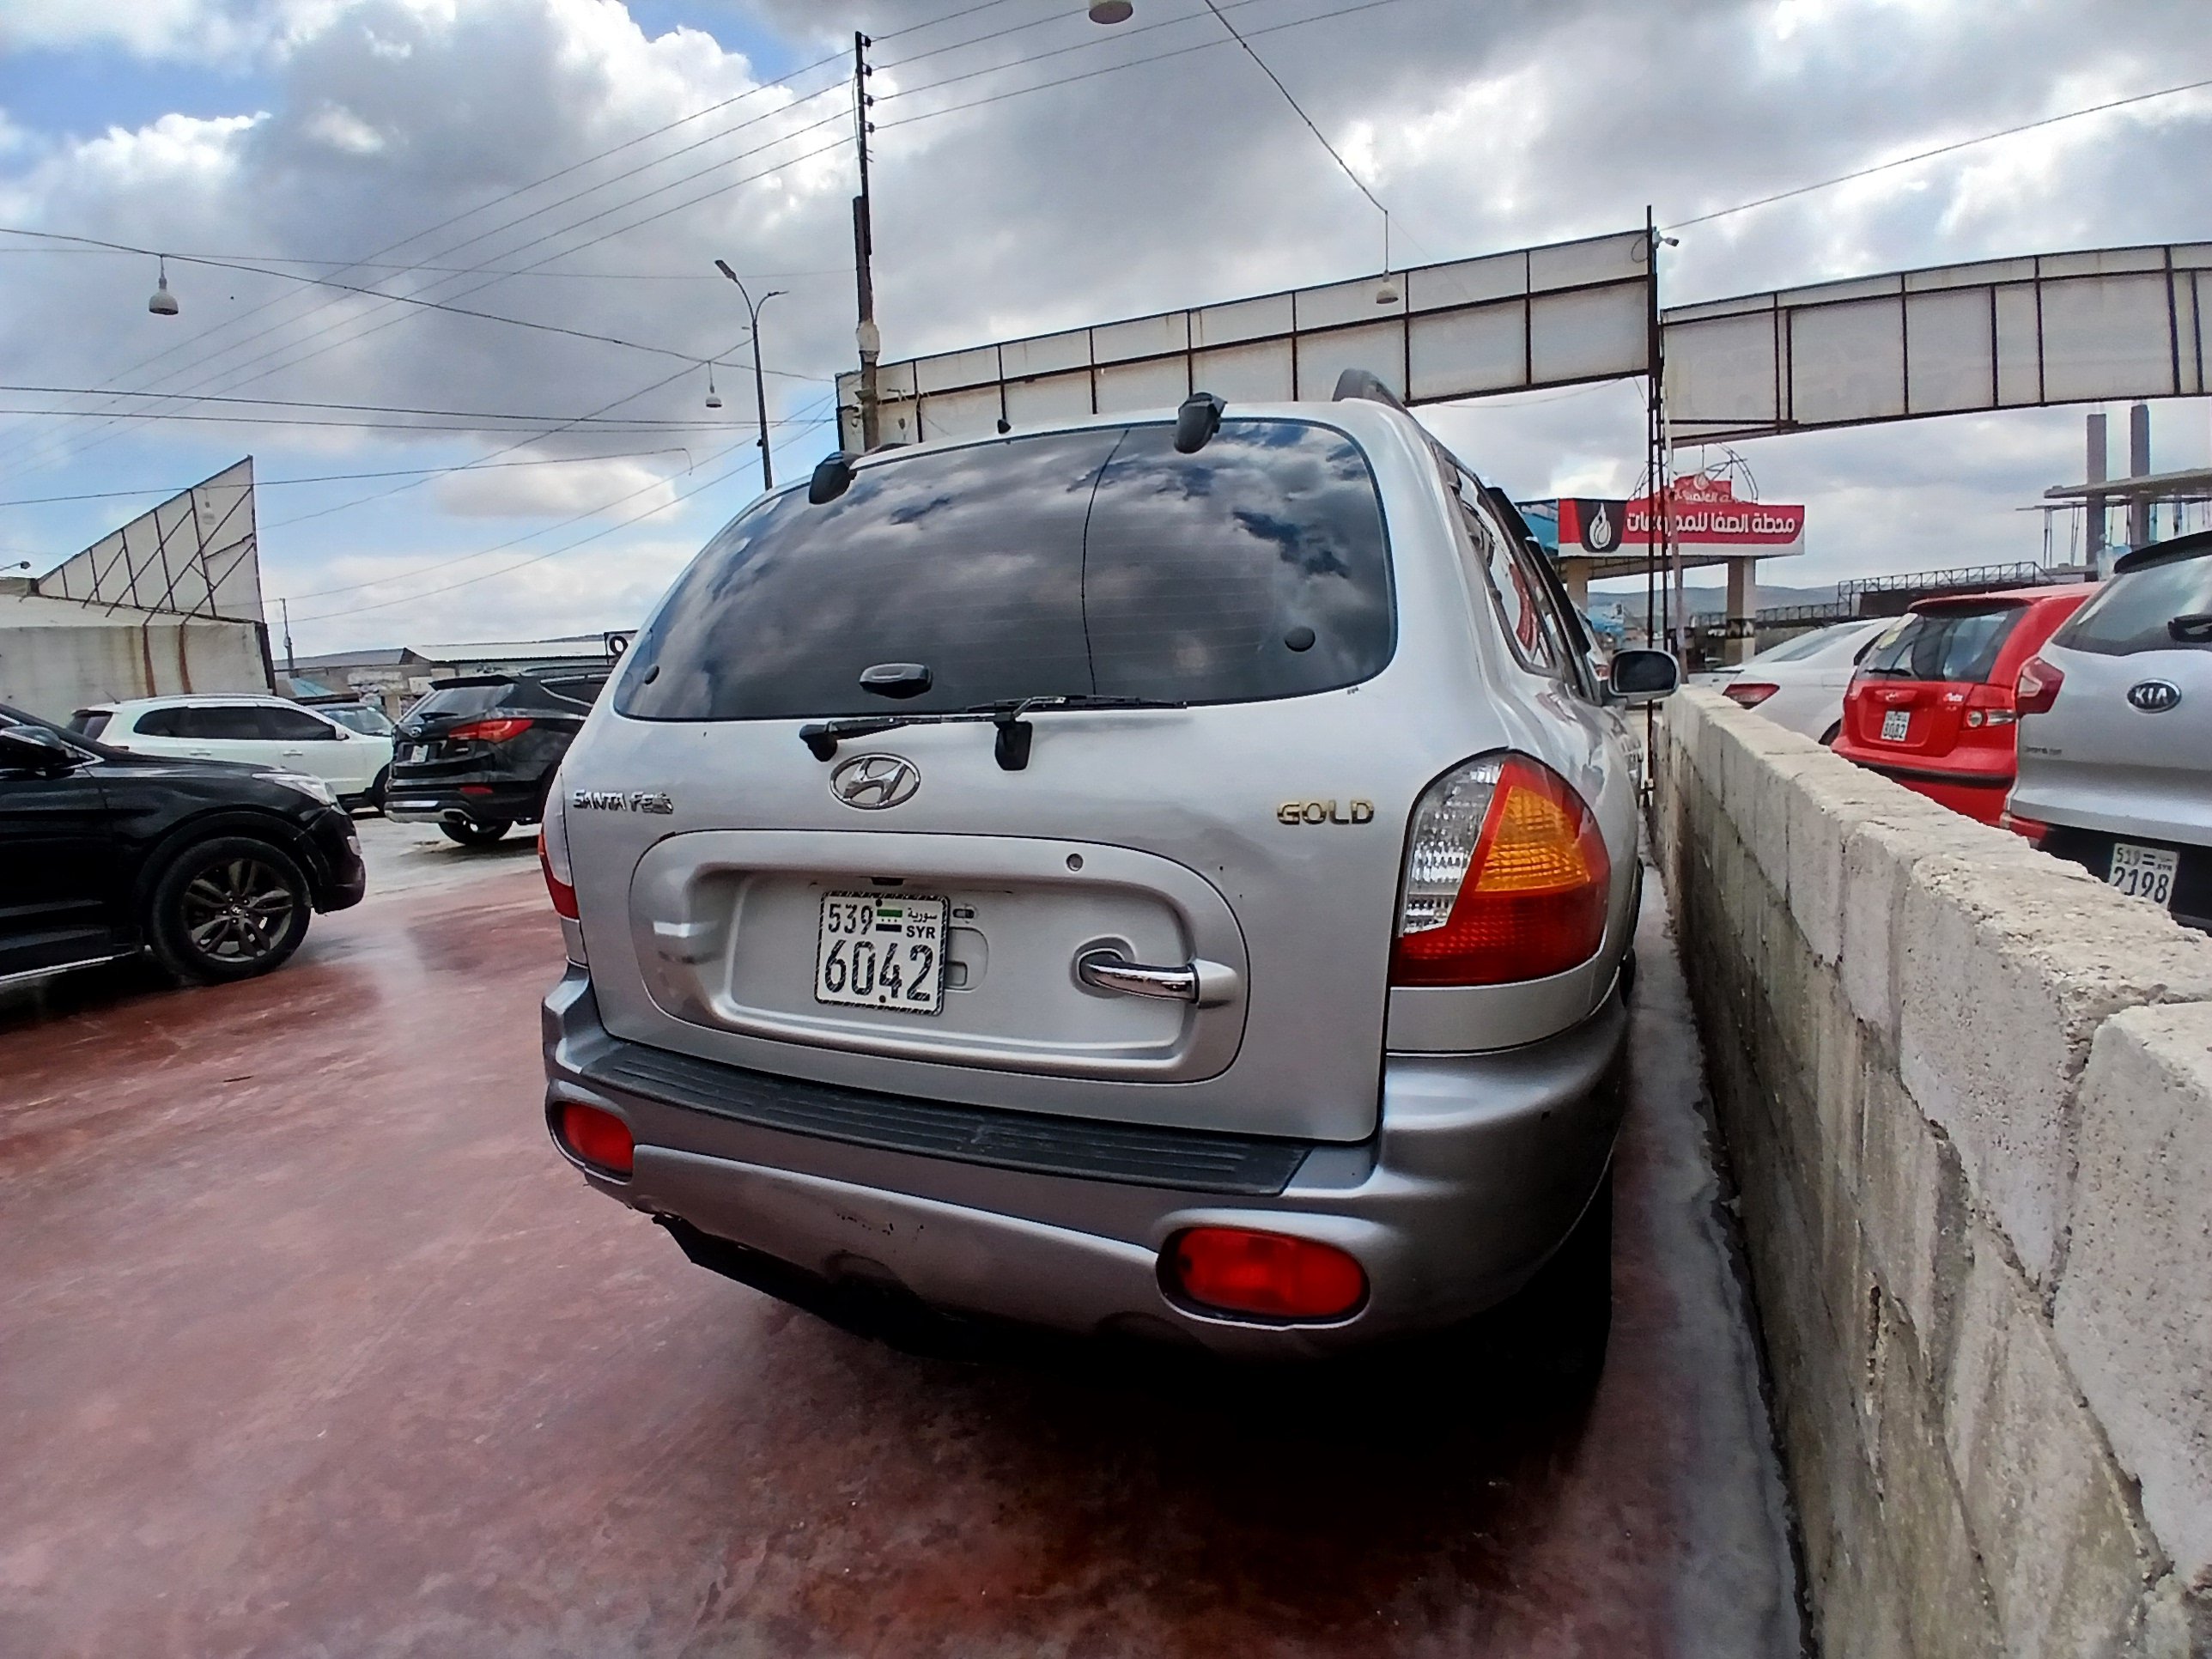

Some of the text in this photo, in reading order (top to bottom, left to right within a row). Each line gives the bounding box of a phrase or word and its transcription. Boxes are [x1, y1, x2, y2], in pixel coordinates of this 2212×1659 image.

[1711, 511, 1749, 533] الصفا
[1752, 514, 1796, 533] محطة
[2135, 688, 2168, 704] KIA
[573, 789, 627, 811] SANTA
[1277, 799, 1374, 825] GOLD
[2113, 866, 2169, 904] 2198
[828, 903, 873, 935] 539
[907, 908, 938, 923] سورية
[906, 925, 936, 939] SYR
[824, 939, 933, 1002] 6042
